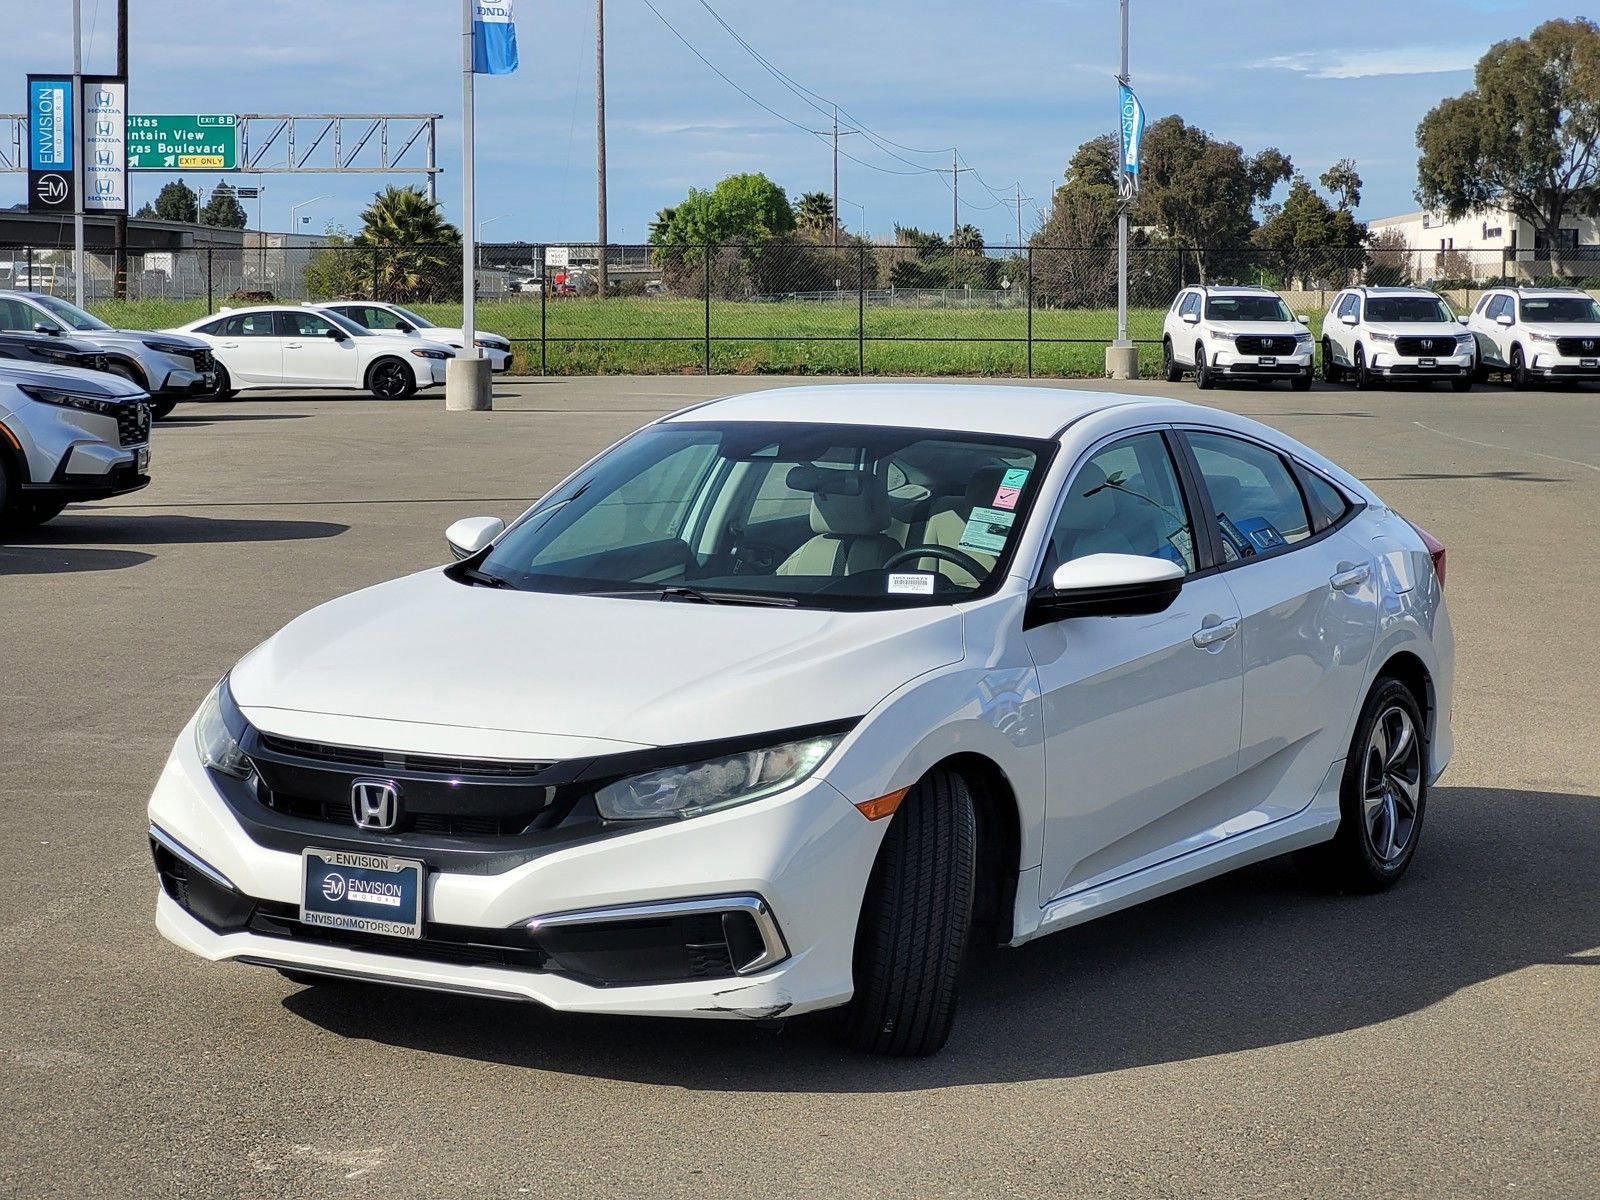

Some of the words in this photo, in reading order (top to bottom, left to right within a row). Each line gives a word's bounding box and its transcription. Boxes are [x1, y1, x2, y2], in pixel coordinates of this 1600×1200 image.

[39, 88, 53, 163] ENVISION
[173, 130, 205, 140] View
[128, 145, 151, 153] ras
[158, 143, 225, 153] Boulevard
[336, 853, 389, 869] ENVISION
[348, 878, 402, 897] ENVISION
[352, 893, 396, 904] MOTORS
[305, 913, 415, 936] ENVISIONMOTORS.COM
